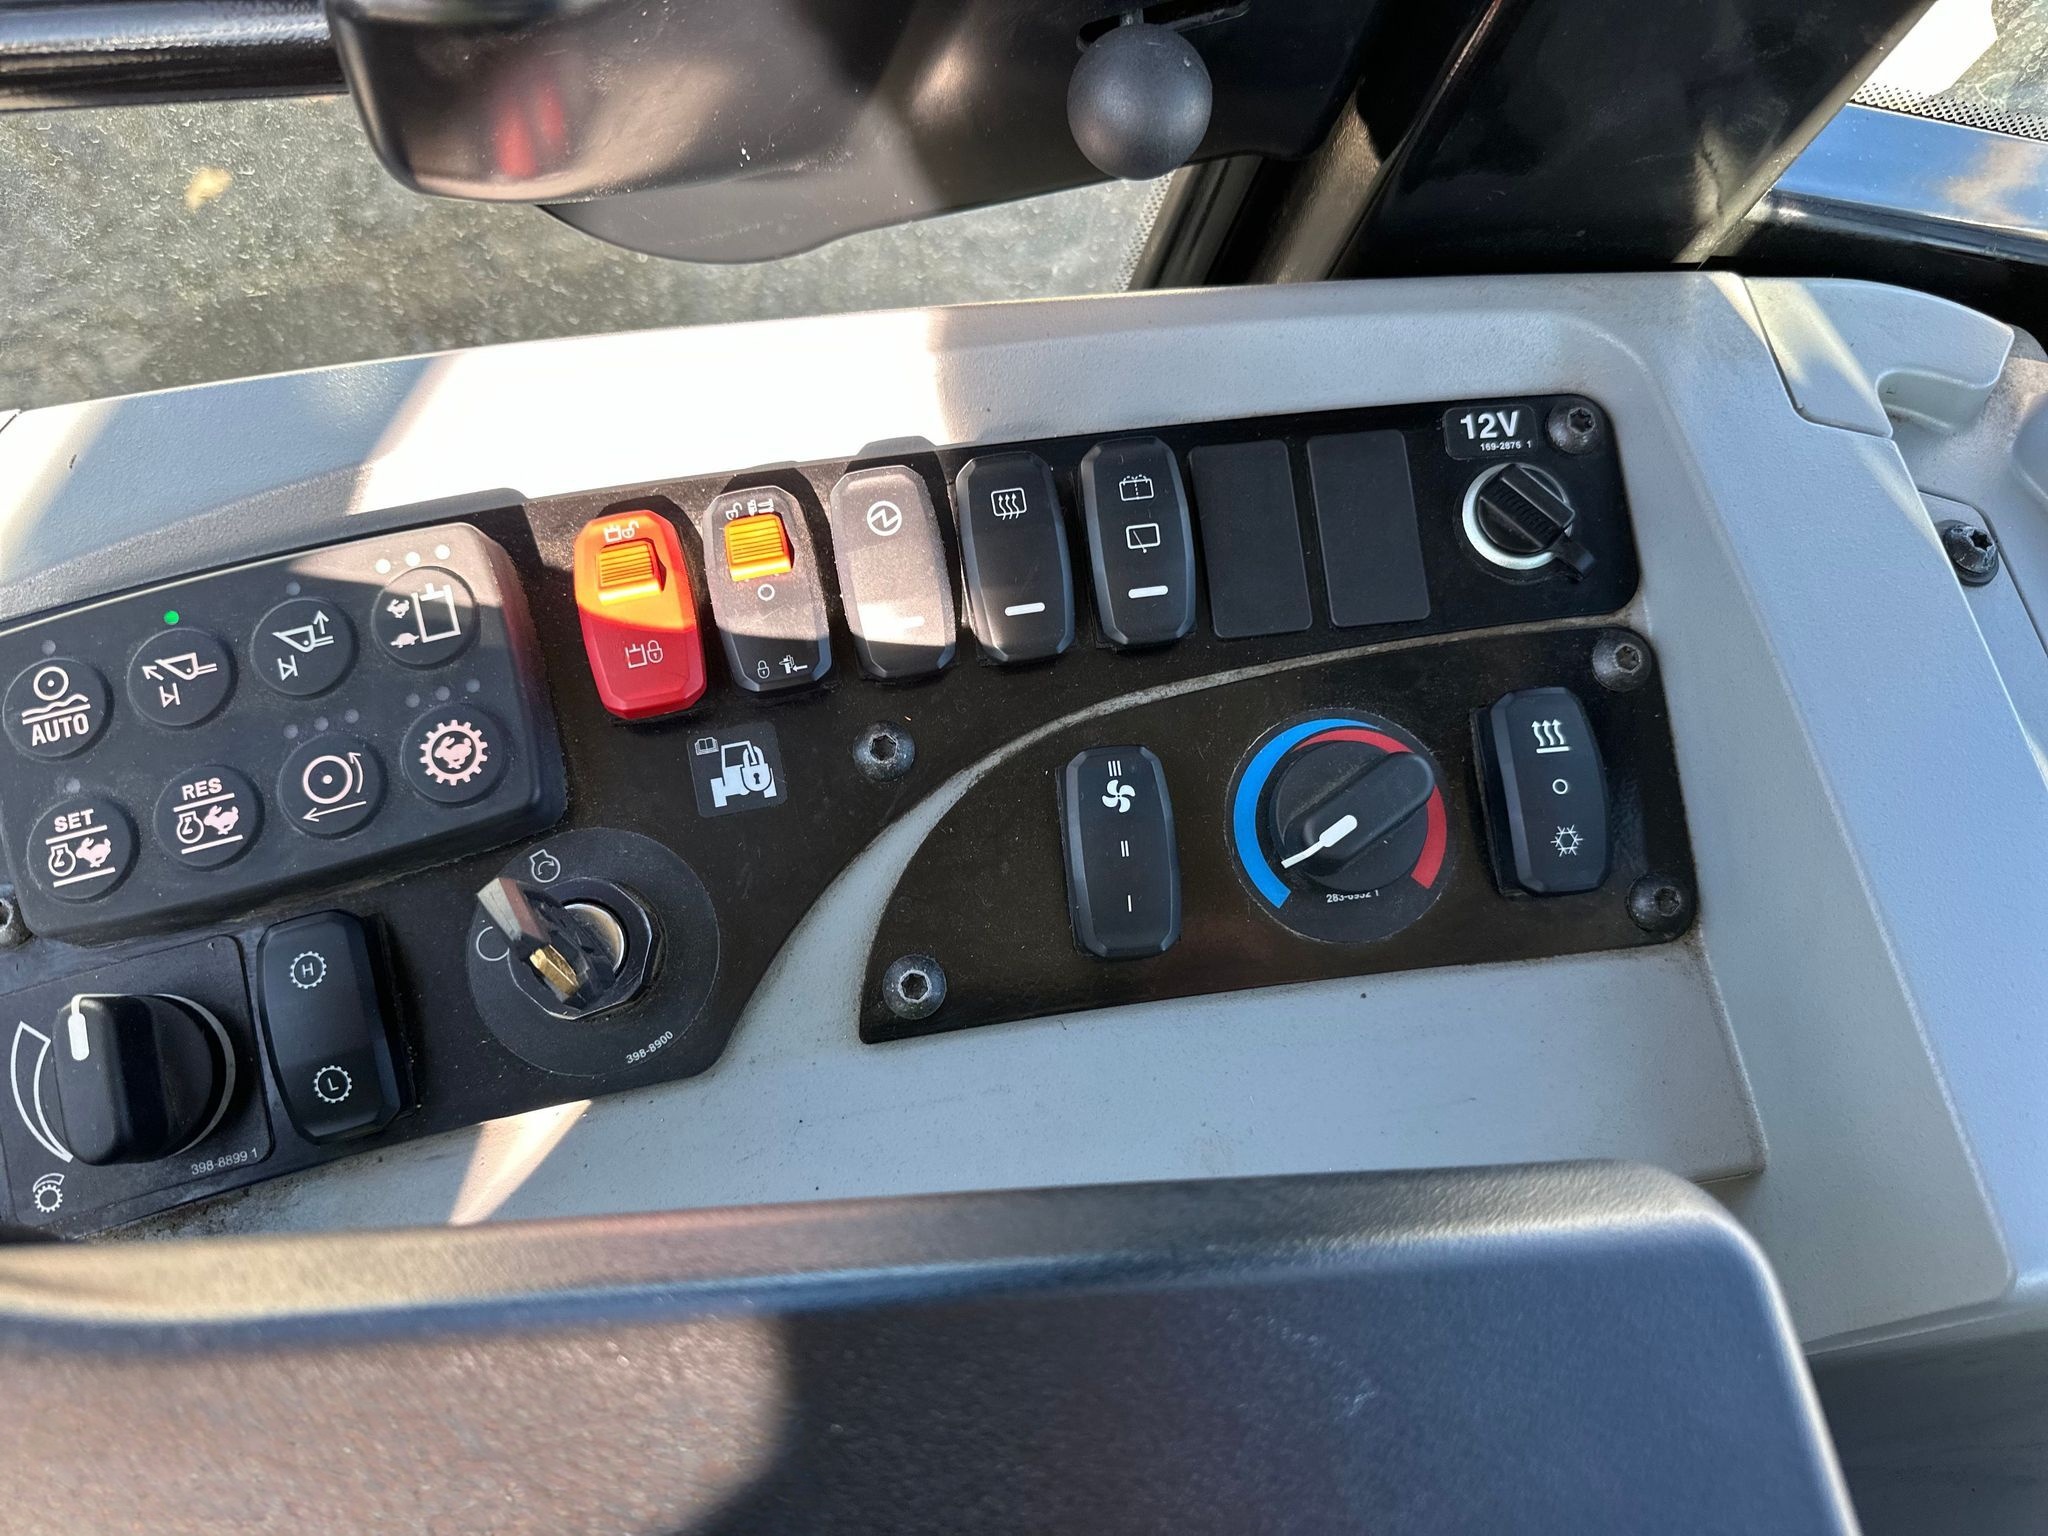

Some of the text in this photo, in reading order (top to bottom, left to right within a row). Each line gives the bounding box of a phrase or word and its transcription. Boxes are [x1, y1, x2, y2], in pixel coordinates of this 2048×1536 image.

[1460, 410, 1519, 439] 12V
[31, 713, 90, 747] AUTO
[181, 777, 223, 801] RES
[54, 808, 95, 834] SET
[302, 962, 314, 978] H
[625, 1030, 674, 1064] 398-8900
[327, 1077, 340, 1092] L
[190, 1150, 248, 1175] 398-8899
